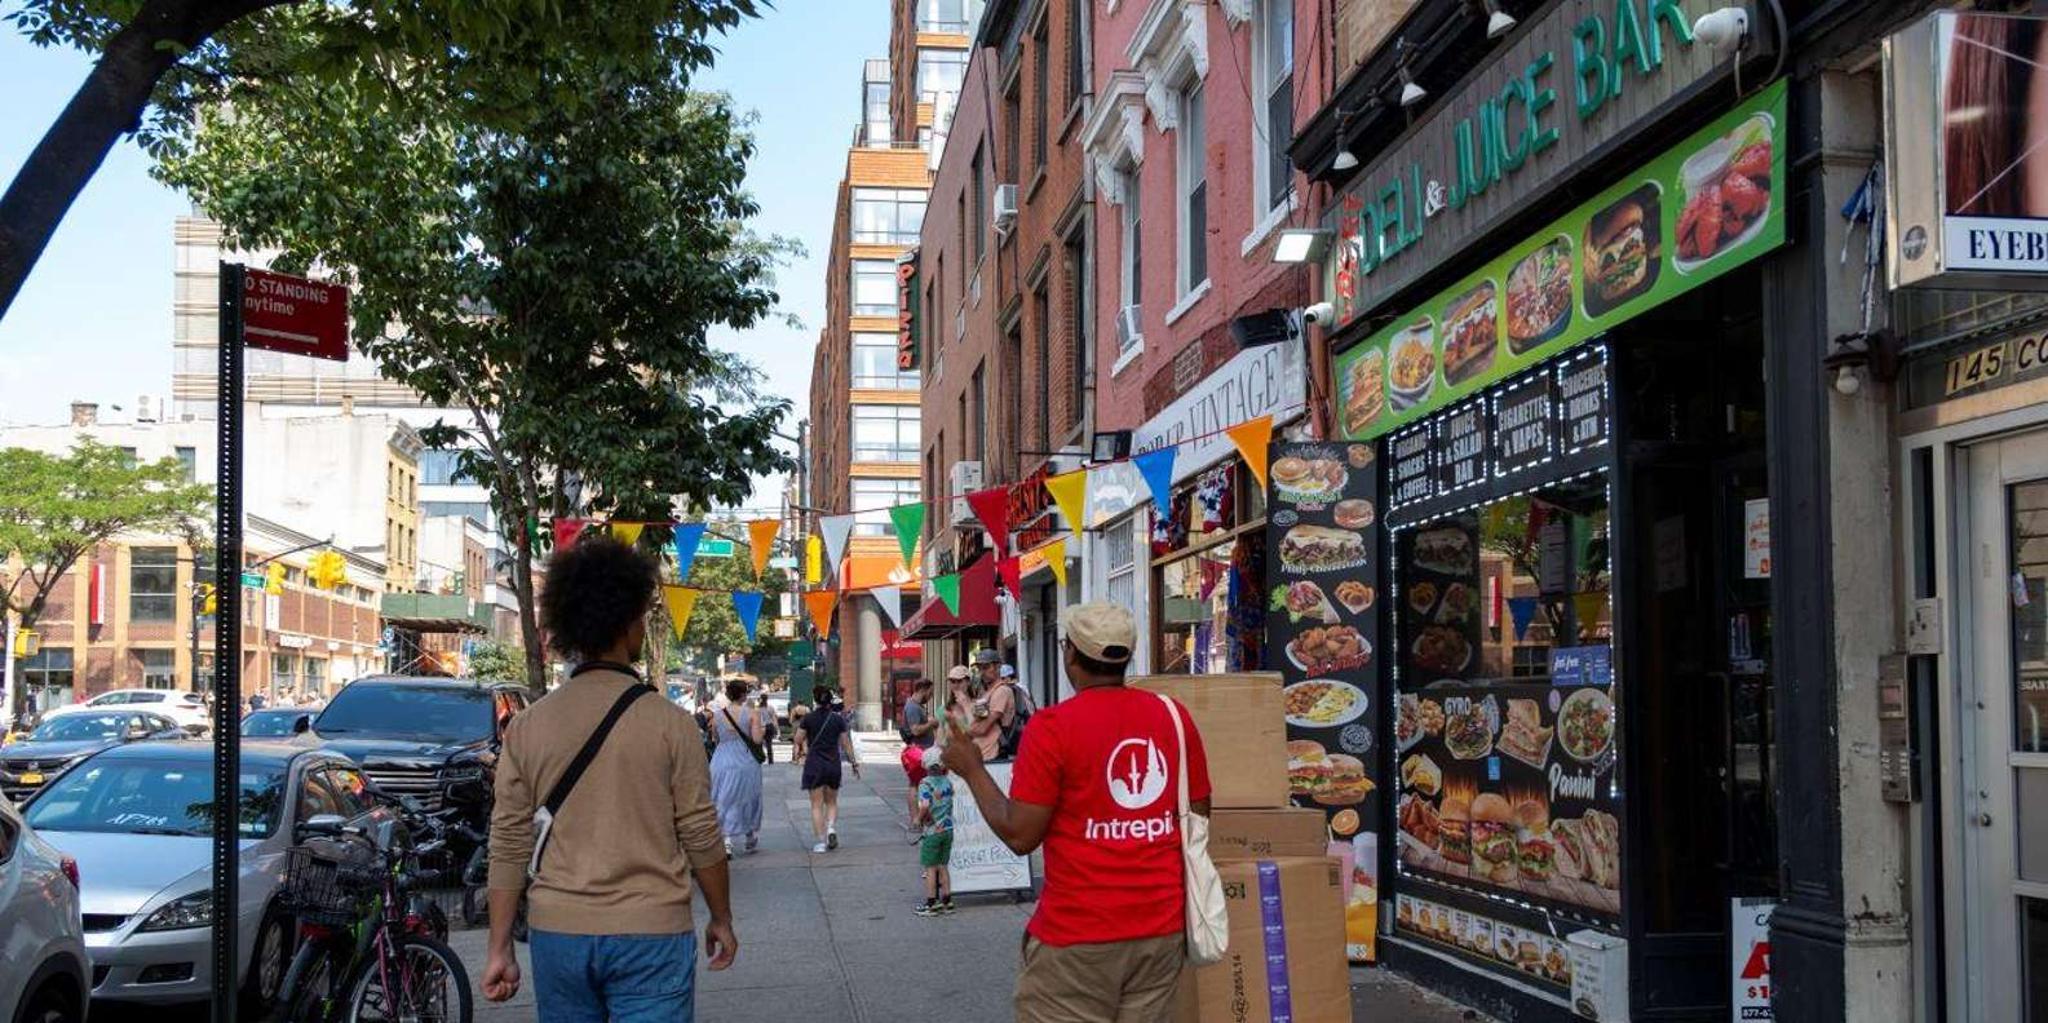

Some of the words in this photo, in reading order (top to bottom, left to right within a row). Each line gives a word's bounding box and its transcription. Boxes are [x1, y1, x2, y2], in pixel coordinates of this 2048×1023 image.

[1360, 163, 1423, 276] DELI
[1425, 180, 1448, 218] &
[1449, 52, 1560, 210] JUICE
[1573, 0, 1694, 120] BAR
[1968, 229, 2048, 261] EYEB
[245, 296, 294, 316] nytime
[259, 279, 328, 303] STANDING
[1952, 347, 2003, 390] 145
[1189, 347, 1279, 451] VINTAGE
[1451, 409, 1477, 440] JUICE
[1512, 421, 1546, 456] VAPES
[1453, 431, 1483, 463] SALAD
[1454, 458, 1475, 485] BAR
[1444, 696, 1472, 716] GYRO
[1548, 762, 1597, 803] Panini
[1085, 810, 1173, 842] Intrepi
